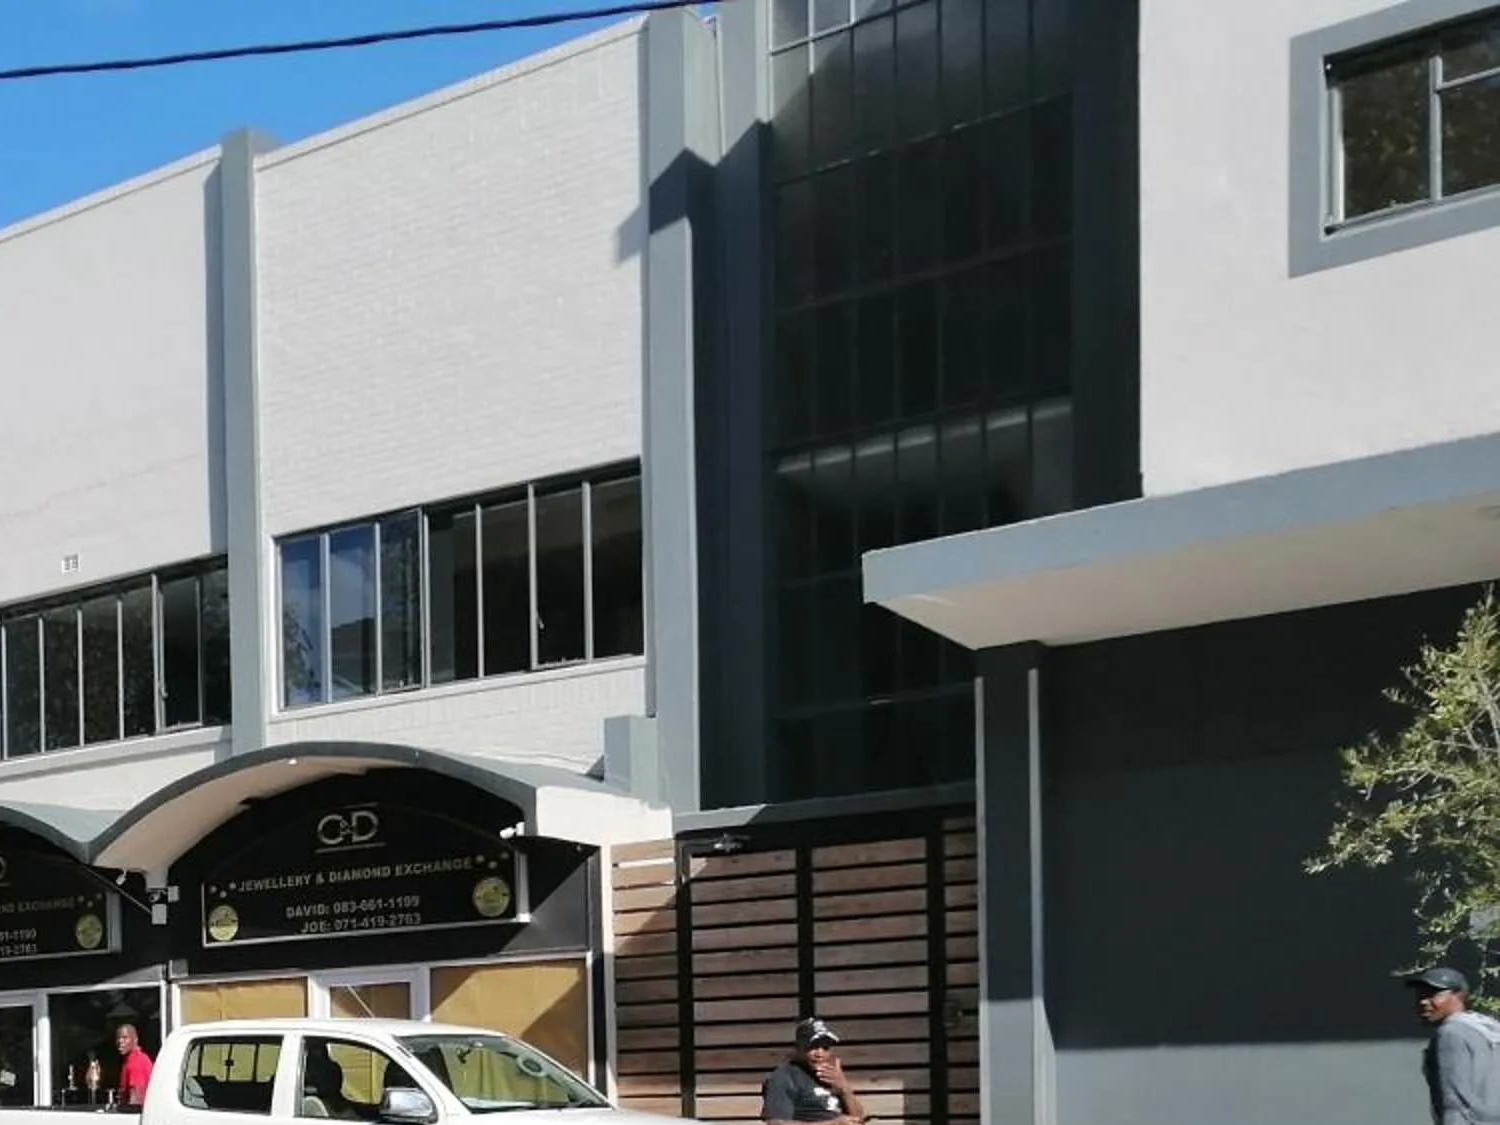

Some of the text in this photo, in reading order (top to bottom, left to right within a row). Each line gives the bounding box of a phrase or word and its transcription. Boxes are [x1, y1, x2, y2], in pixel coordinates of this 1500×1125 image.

[238, 856, 473, 892] JEWELLERY & DIAMOND EXCHANGE
